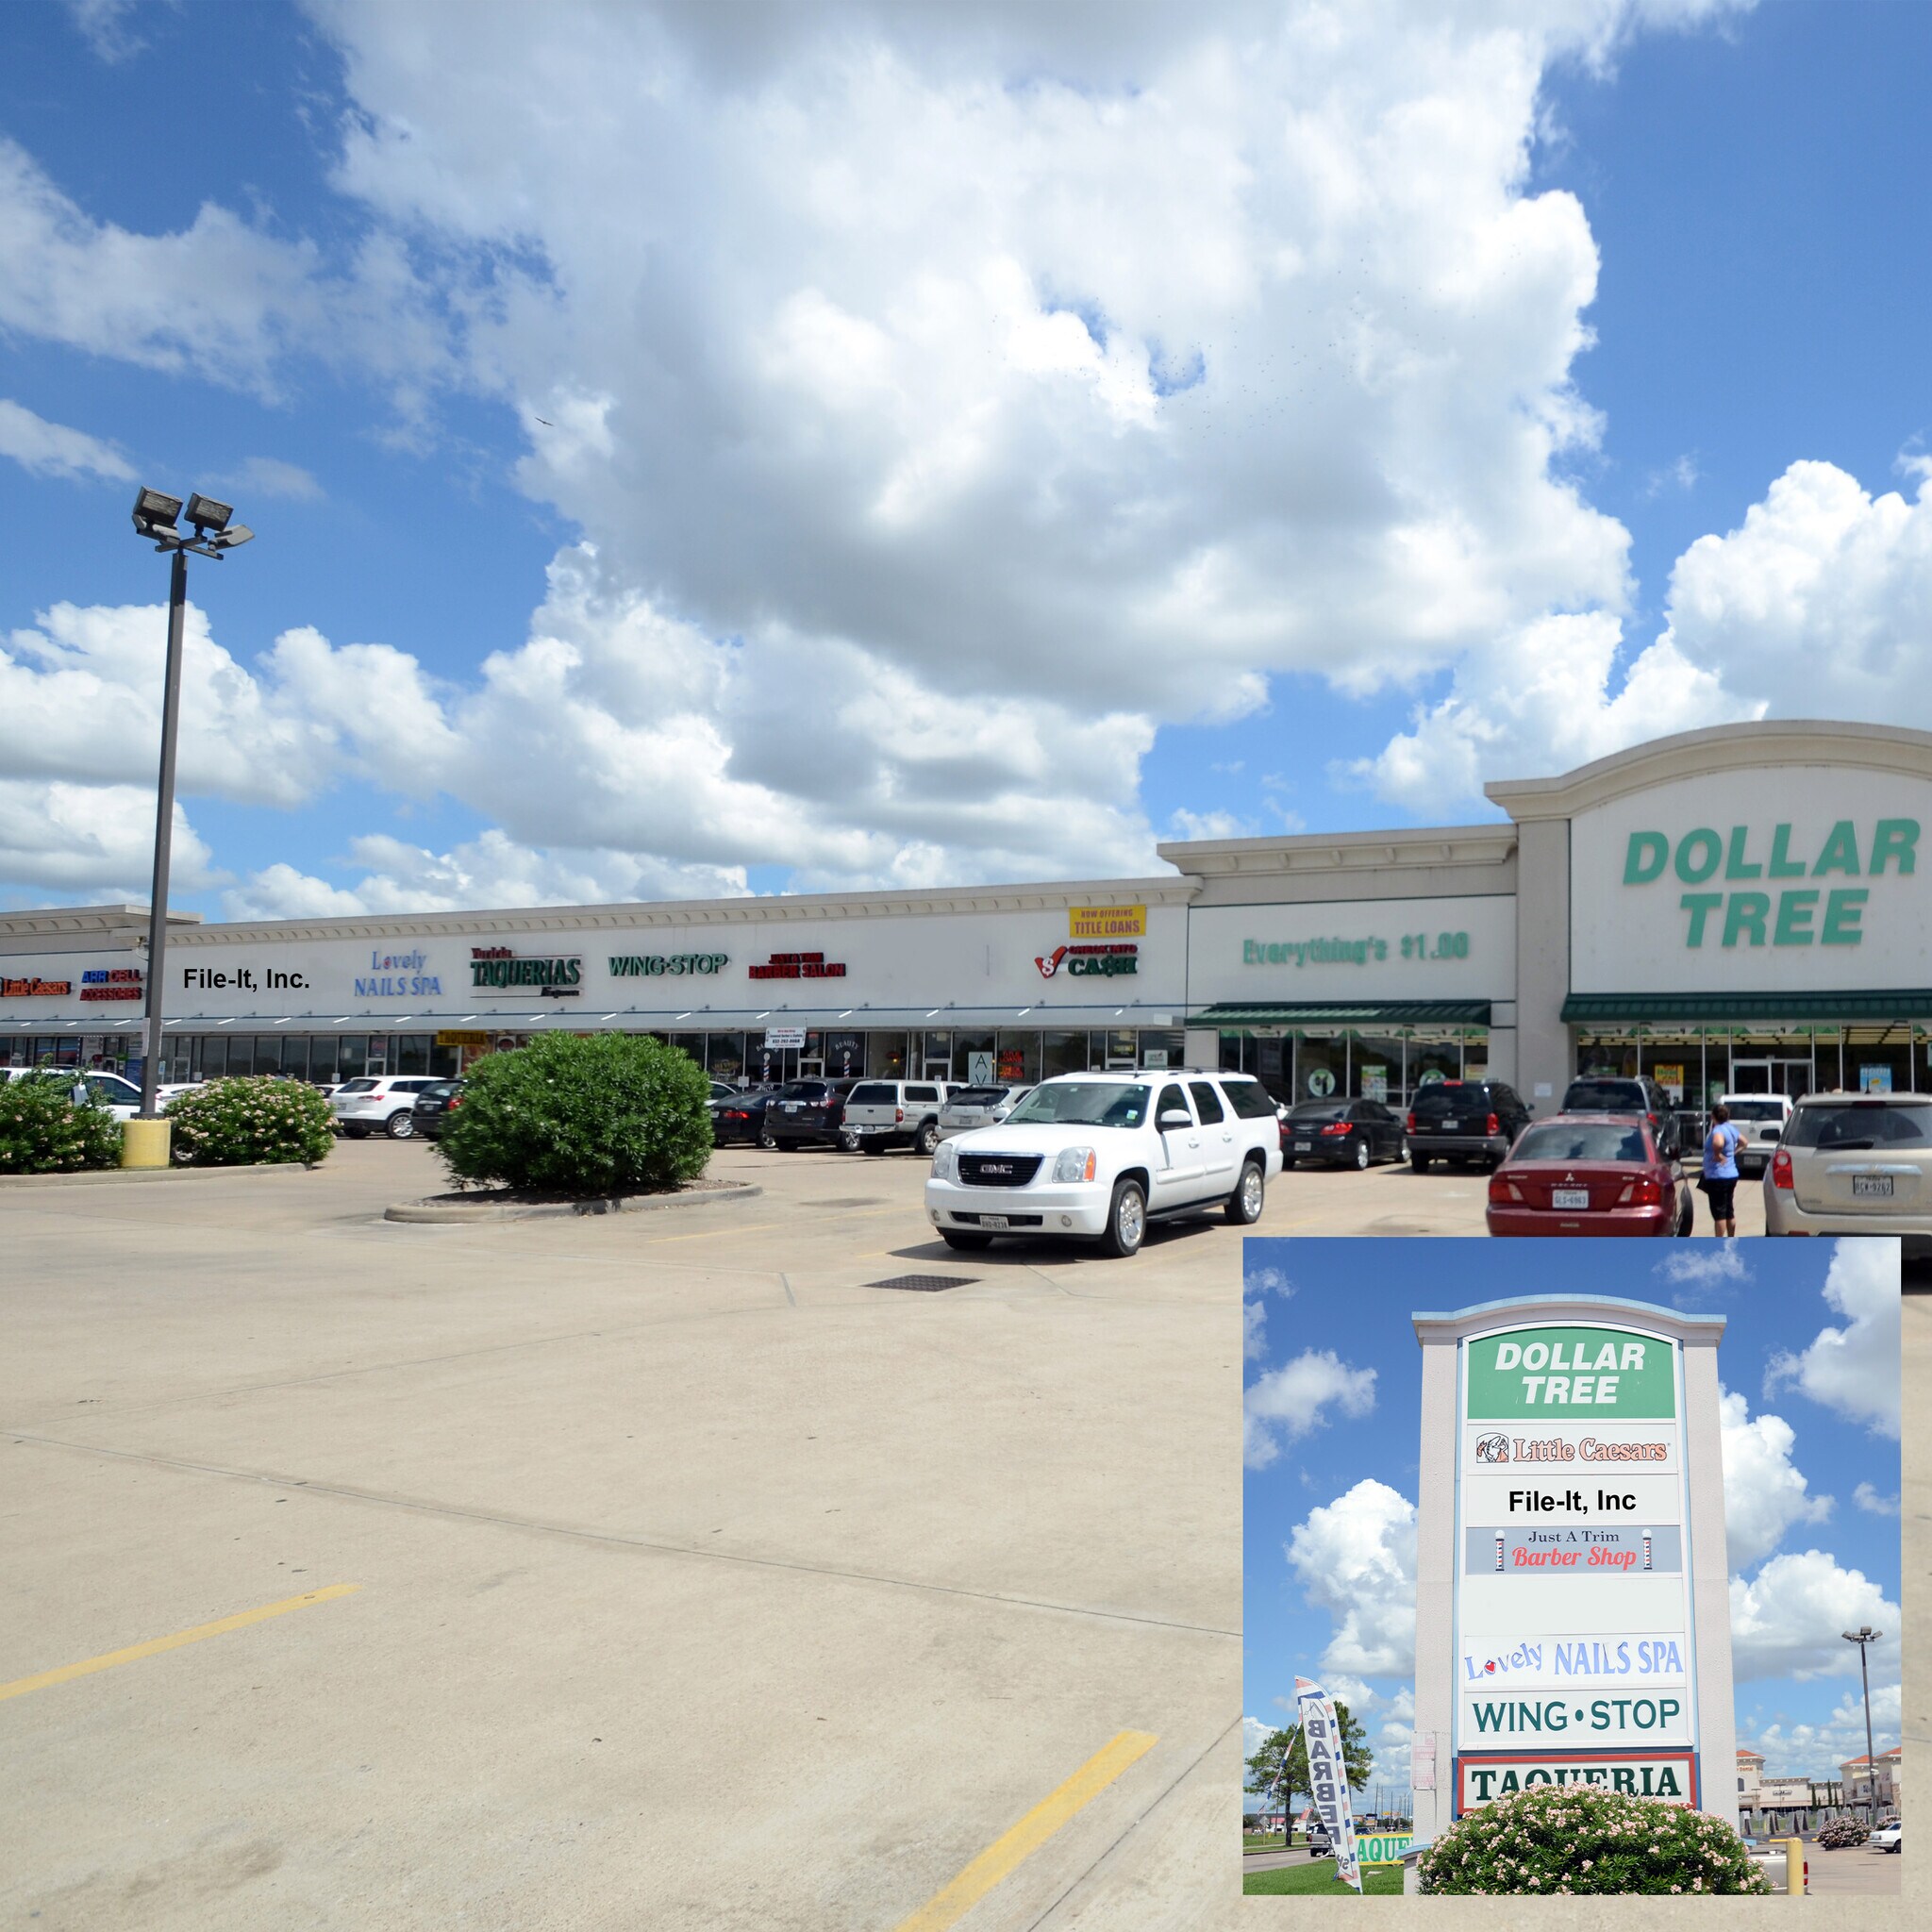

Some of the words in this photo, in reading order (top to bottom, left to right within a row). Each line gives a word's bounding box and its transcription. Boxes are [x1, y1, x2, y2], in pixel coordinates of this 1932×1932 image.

[1623, 818, 1921, 885] DOLLAR
[1074, 922, 1102, 934] TITLE
[1105, 920, 1140, 933] LOANS
[1680, 889, 1870, 948] TREE
[372, 950, 426, 974] Lovely
[1243, 936, 1387, 968] Everything's
[1401, 932, 1469, 959] $1.00
[184, 968, 258, 992] File-It,
[267, 968, 309, 989] Inc.
[471, 958, 581, 989] TAQUERIAS
[749, 965, 801, 978] BARBER
[802, 963, 846, 977] SALON
[30, 977, 70, 995] Caesars
[80, 987, 142, 1001] ACCESSORIES
[355, 977, 406, 996] NAILS
[411, 976, 441, 996] SPA
[835, 1041, 859, 1050] BEAUTY
[980, 1164, 1012, 1174] GMC
[1495, 1342, 1645, 1371] DOLLAR
[1522, 1375, 1620, 1405] TREE
[1513, 1438, 1575, 1462] Little
[1579, 1438, 1667, 1461] Caesars
[1509, 1491, 1588, 1514] File-It,
[1597, 1490, 1637, 1510] Inc
[1528, 1531, 1561, 1542] Just
[1566, 1531, 1578, 1542] A
[1581, 1530, 1619, 1542] Trim
[1511, 1547, 1582, 1566] Barber
[1588, 1546, 1637, 1571] Shop
[1464, 1642, 1541, 1680] Lovely
[1555, 1641, 1630, 1675] NAILS
[1638, 1641, 1684, 1674] SPA
[1357, 1837, 1413, 1862] AQUE
